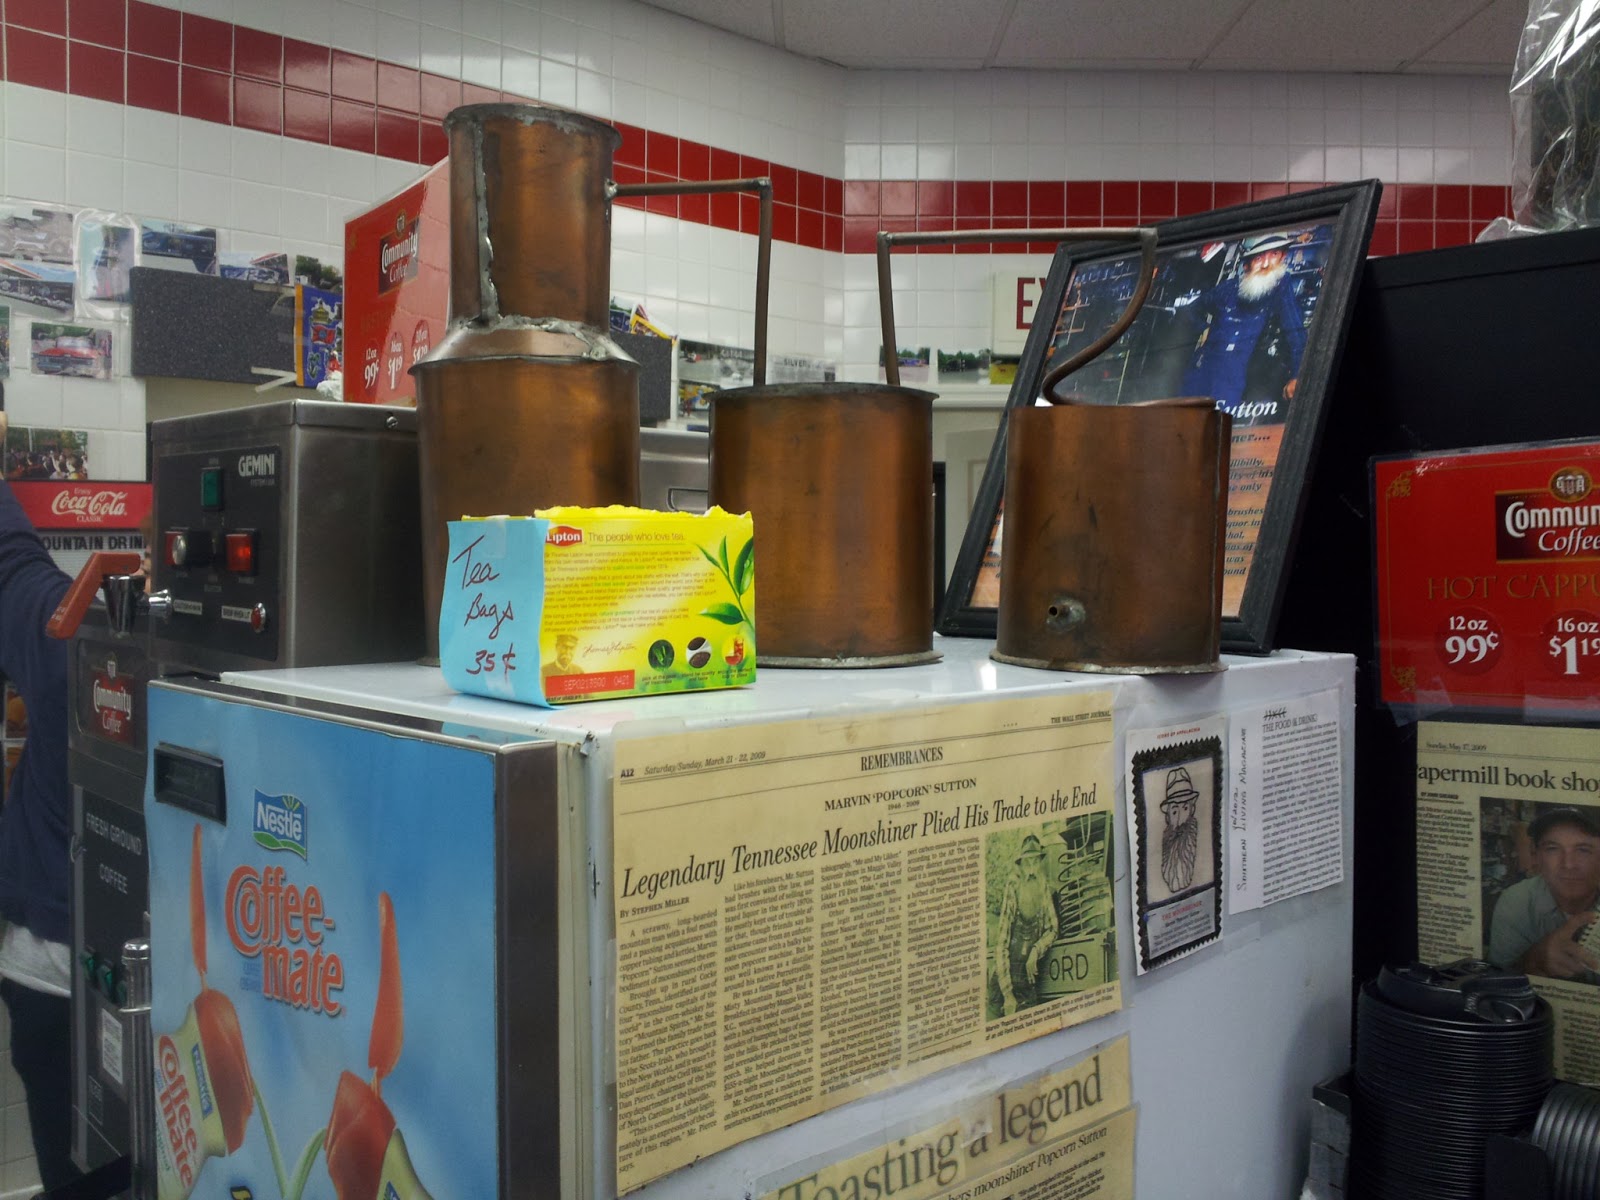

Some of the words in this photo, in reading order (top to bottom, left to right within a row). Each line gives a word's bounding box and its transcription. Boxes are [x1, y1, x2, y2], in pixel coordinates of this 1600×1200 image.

[381, 232, 418, 274] Community
[389, 262, 408, 283] Coffee
[1016, 277, 1046, 330] E
[238, 453, 275, 477] GEMINI
[1240, 482, 1262, 492] only
[51, 490, 128, 515] Coca-Cola
[1227, 508, 1264, 516] brushes
[1505, 501, 1600, 538] Commun
[43, 536, 104, 551] OUNTAIN
[108, 536, 146, 550] DRIN
[546, 531, 581, 544] Lipton
[588, 532, 603, 541] The
[605, 532, 633, 543] people
[635, 532, 653, 541] who
[654, 531, 670, 541] love
[1538, 527, 1600, 556] Coffee
[452, 534, 500, 591] Tea
[1428, 575, 1498, 600] HOT
[464, 592, 514, 640] Bags
[93, 679, 132, 720] Community
[103, 710, 122, 735] Coffee
[1051, 716, 1061, 724] THE
[1075, 712, 1089, 721] STREET
[1262, 723, 1275, 733] THE
[1275, 719, 1291, 731] FOOD
[620, 768, 635, 778] A12
[705, 756, 725, 767] March
[750, 751, 766, 761] 2009
[861, 746, 943, 772] REMEMBRANCES
[1417, 766, 1498, 785] apermill
[1505, 767, 1556, 790] book
[1562, 771, 1600, 793] sho
[824, 793, 871, 812] MARVIN
[934, 778, 977, 794] SUTTON
[906, 800, 920, 809] 2009
[86, 812, 111, 839] FRESH
[110, 824, 142, 855] GROUND
[621, 855, 725, 901] Legendary
[731, 840, 818, 874] Tennessee
[821, 819, 918, 856] Moonshiner
[920, 806, 960, 837] Plied
[964, 804, 989, 829] His
[993, 795, 1030, 824] Trade
[1034, 796, 1047, 815] to
[1050, 789, 1068, 813] the
[1070, 783, 1097, 809] End
[99, 862, 129, 895] COFFEE
[666, 928, 681, 939] with
[1049, 953, 1089, 981] ORD
[261, 944, 346, 1018] mate
[778, 1130, 959, 1200] Toasting
[969, 1119, 989, 1158] a
[997, 1055, 1103, 1146] legend
[645, 1143, 658, 1154] this
[973, 1160, 1036, 1198] moonshiner
[1037, 1142, 1077, 1168] Popcorn
[1077, 1127, 1108, 1150] Sutton
